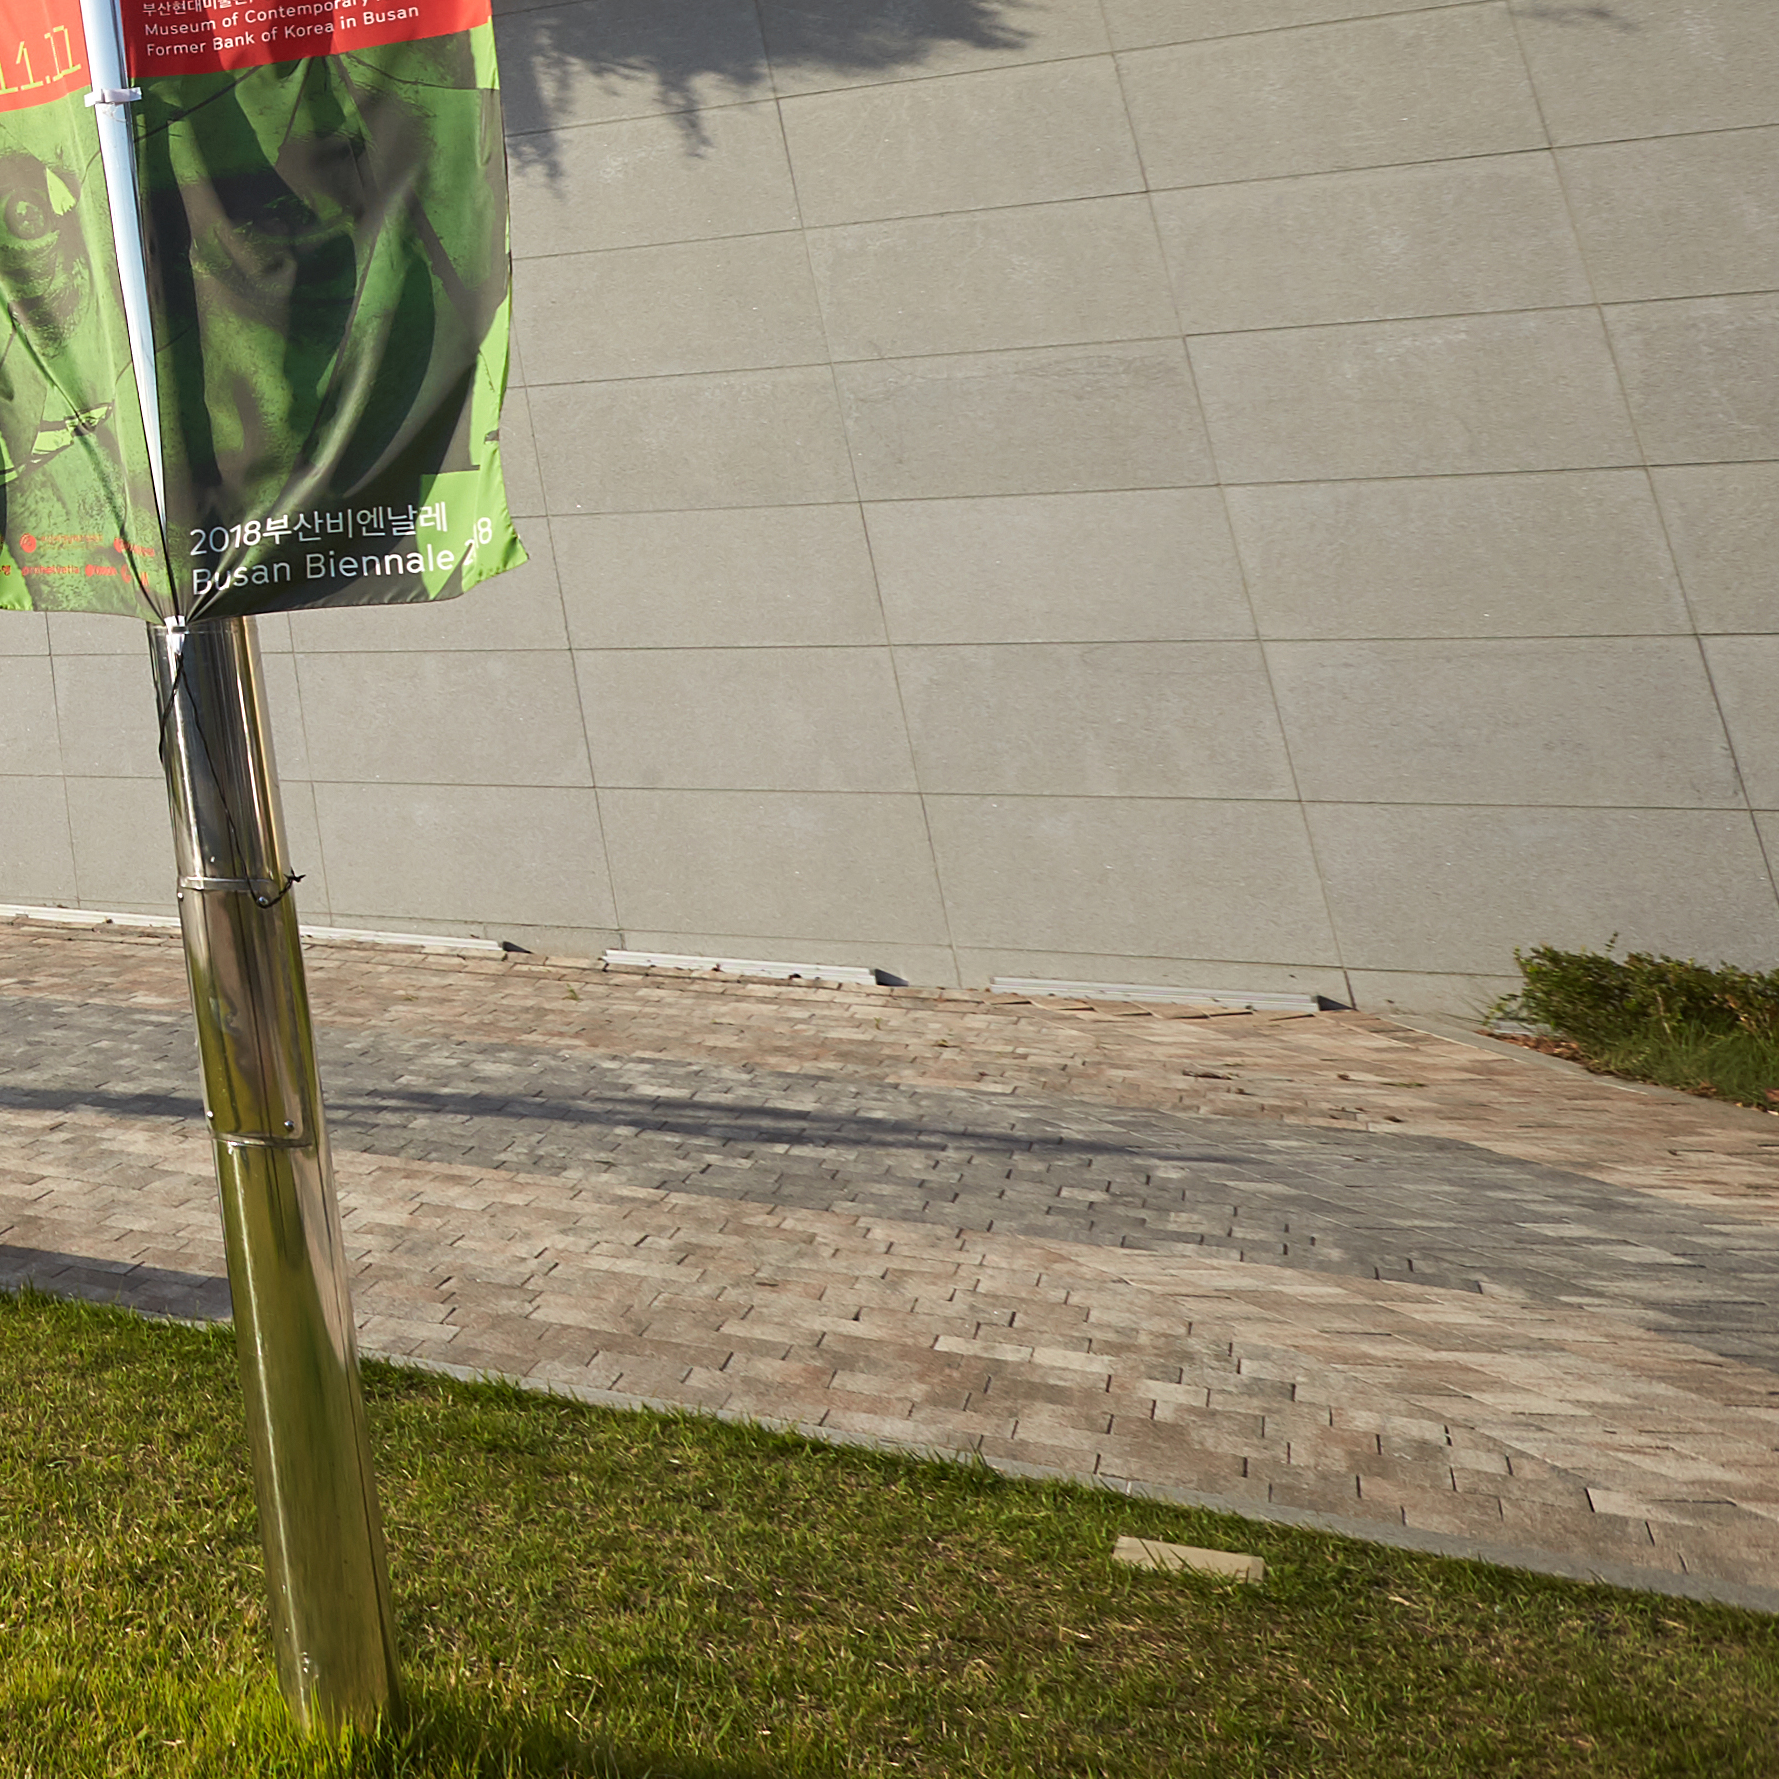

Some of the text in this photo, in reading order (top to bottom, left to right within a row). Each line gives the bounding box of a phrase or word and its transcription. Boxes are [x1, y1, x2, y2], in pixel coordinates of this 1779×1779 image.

[144, 18, 217, 37] Museum
[221, 13, 239, 28] of
[146, 4, 420, 57] Former Bank of Korea in Busan
[191, 560, 292, 596] Busan
[306, 542, 455, 580] Biennale
